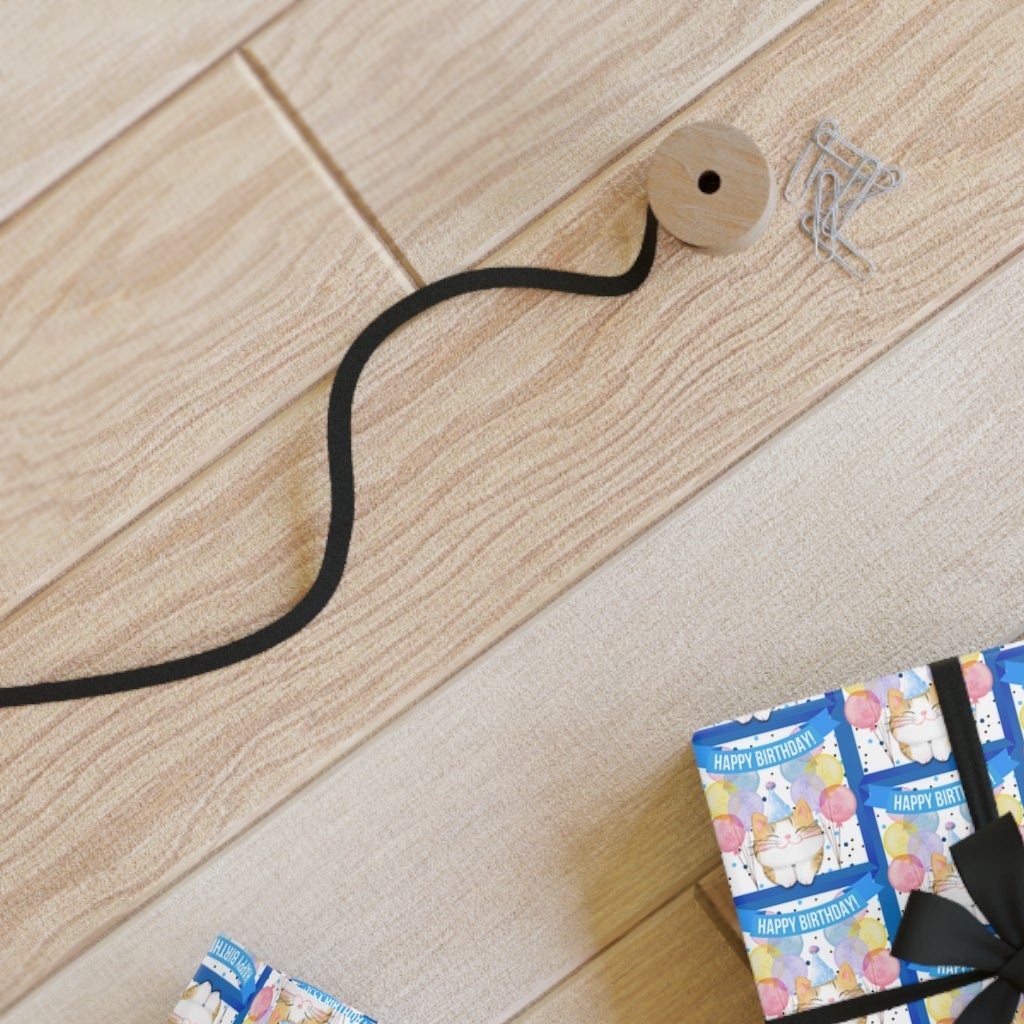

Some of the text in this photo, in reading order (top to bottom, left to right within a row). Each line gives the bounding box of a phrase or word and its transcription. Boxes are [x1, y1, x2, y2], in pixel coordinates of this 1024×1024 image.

[714, 730, 815, 771] HAPPY BIRTHDAY!
[894, 793, 932, 811] HAPPY
[758, 895, 857, 935] HAPPY BIRTHDAY!
[209, 938, 241, 966] BIRTH
